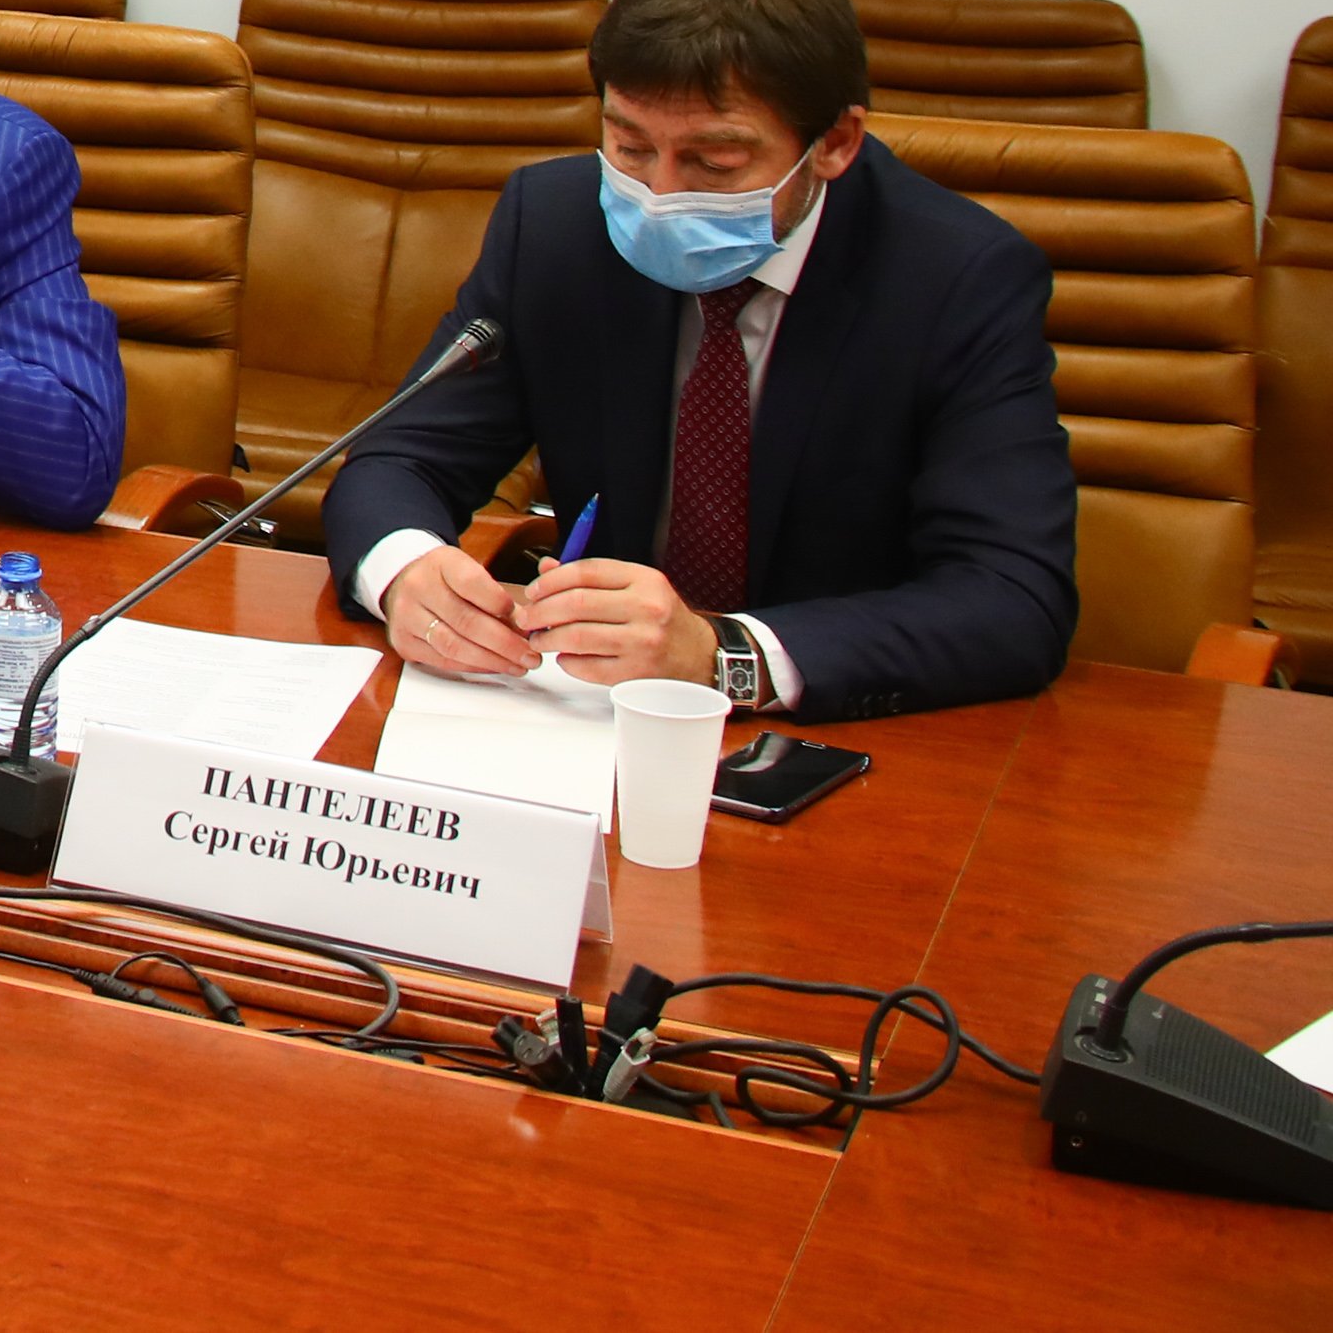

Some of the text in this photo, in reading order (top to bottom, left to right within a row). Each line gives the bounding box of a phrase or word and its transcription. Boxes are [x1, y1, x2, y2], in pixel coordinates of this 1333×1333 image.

[201, 765, 462, 842] ПАНТЕЛЕЕВ
[163, 809, 482, 900] Сергей Юрьевич
